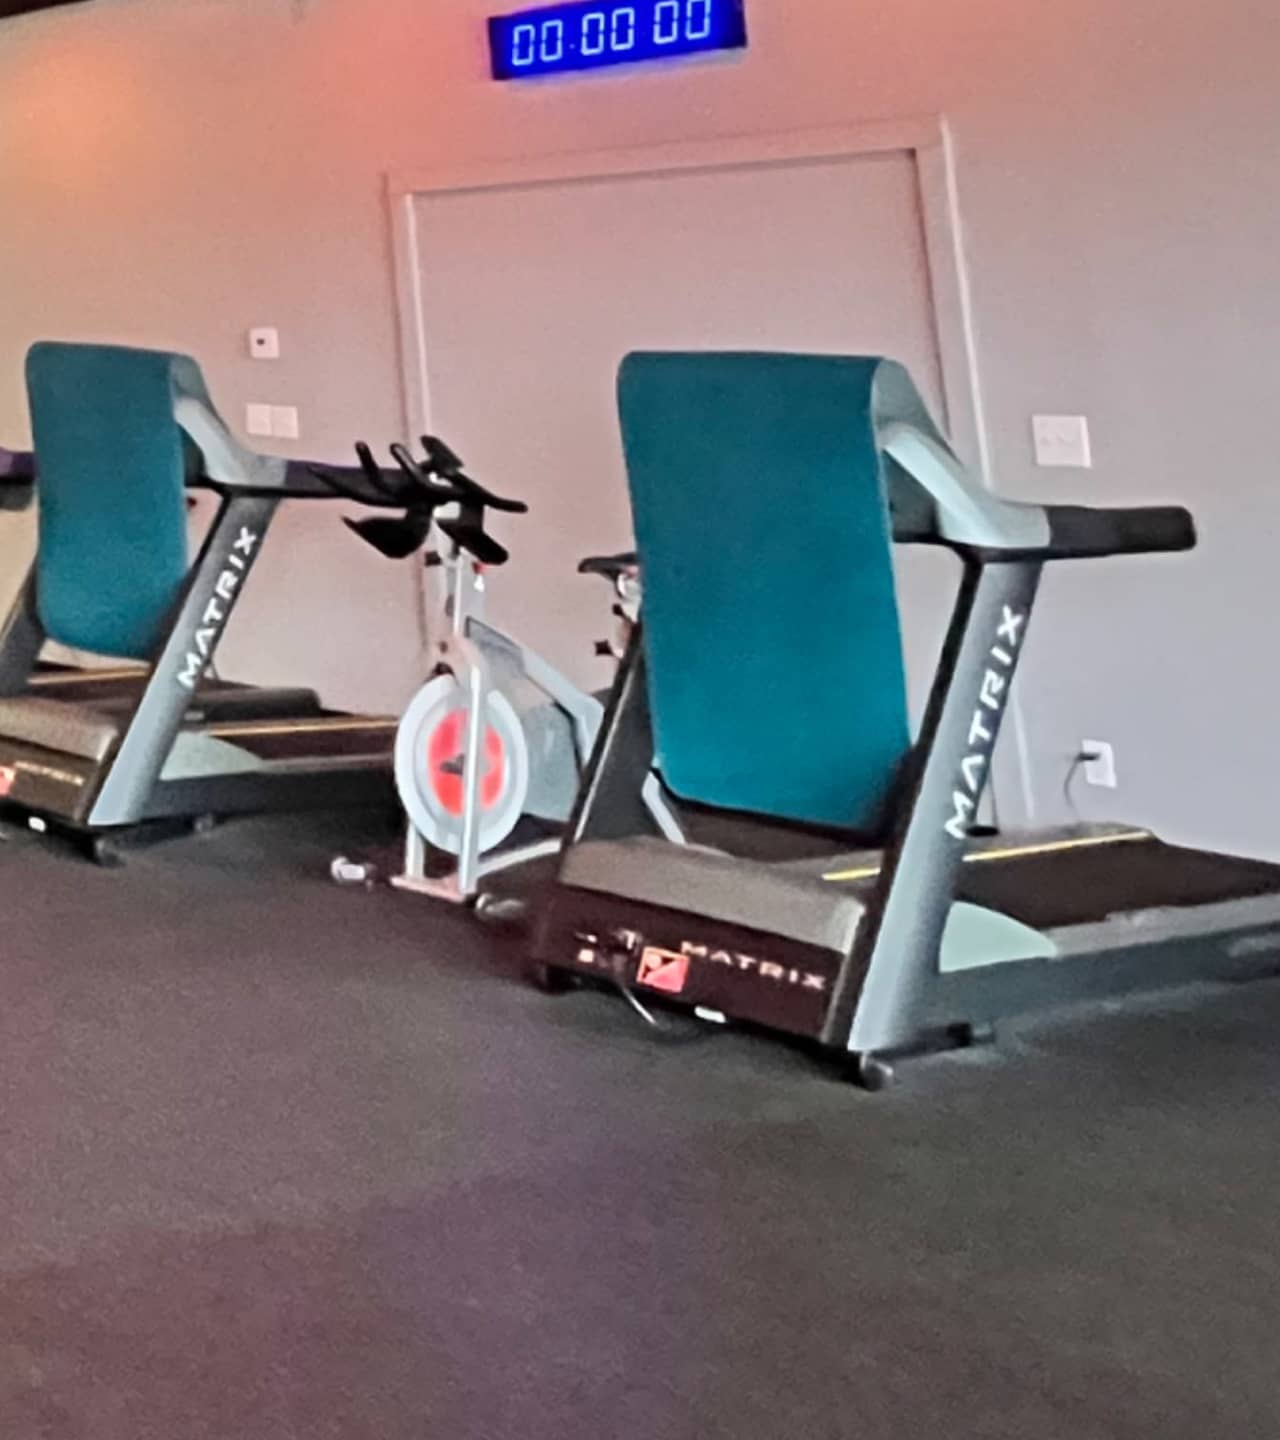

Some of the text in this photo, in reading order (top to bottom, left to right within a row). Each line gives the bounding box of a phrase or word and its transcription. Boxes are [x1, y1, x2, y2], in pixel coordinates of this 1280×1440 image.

[177, 526, 257, 689] MATRIX
[944, 604, 1023, 839] MATRIX
[680, 940, 826, 990] MATRIX
